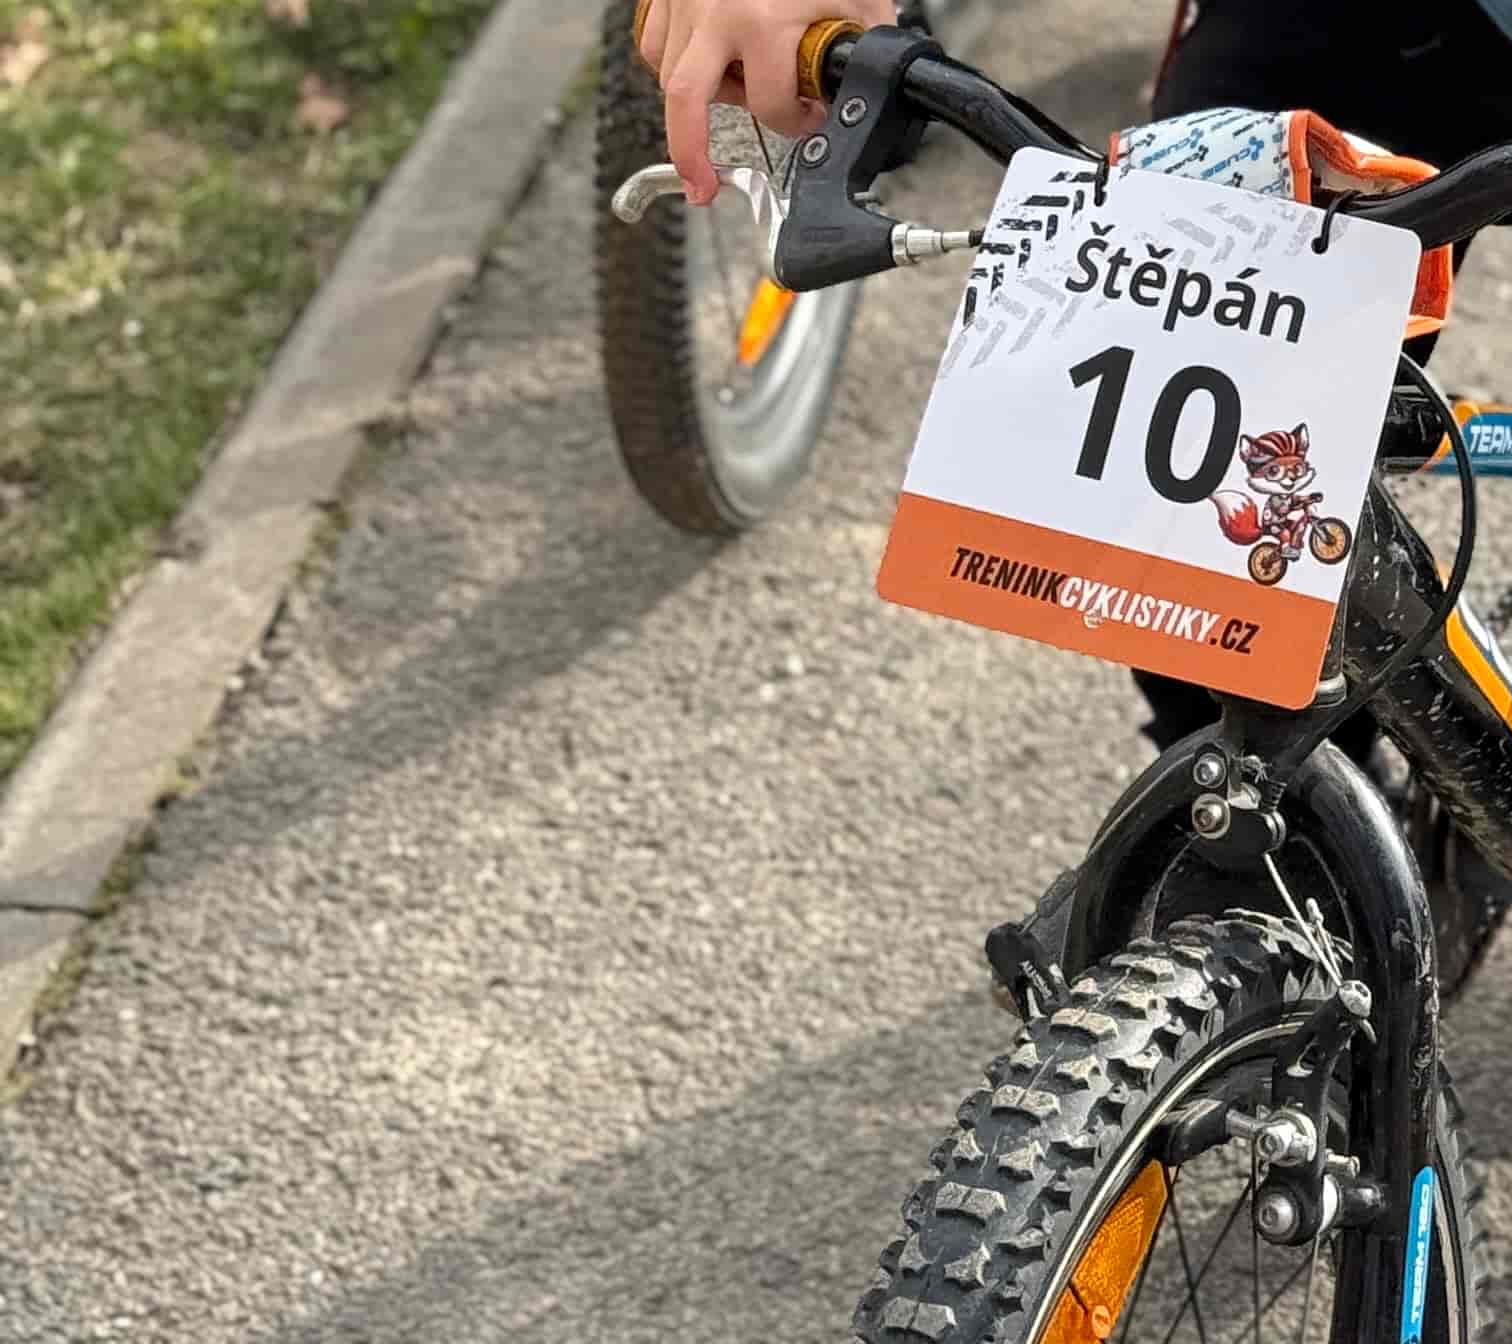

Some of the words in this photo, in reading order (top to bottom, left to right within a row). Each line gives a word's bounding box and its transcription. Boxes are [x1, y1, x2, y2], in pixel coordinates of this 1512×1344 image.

[1065, 223, 1308, 343] Štěpán
[1067, 344, 1242, 504] 10
[950, 546, 1260, 655] TRENINKCYKLISTIKY.CZ
